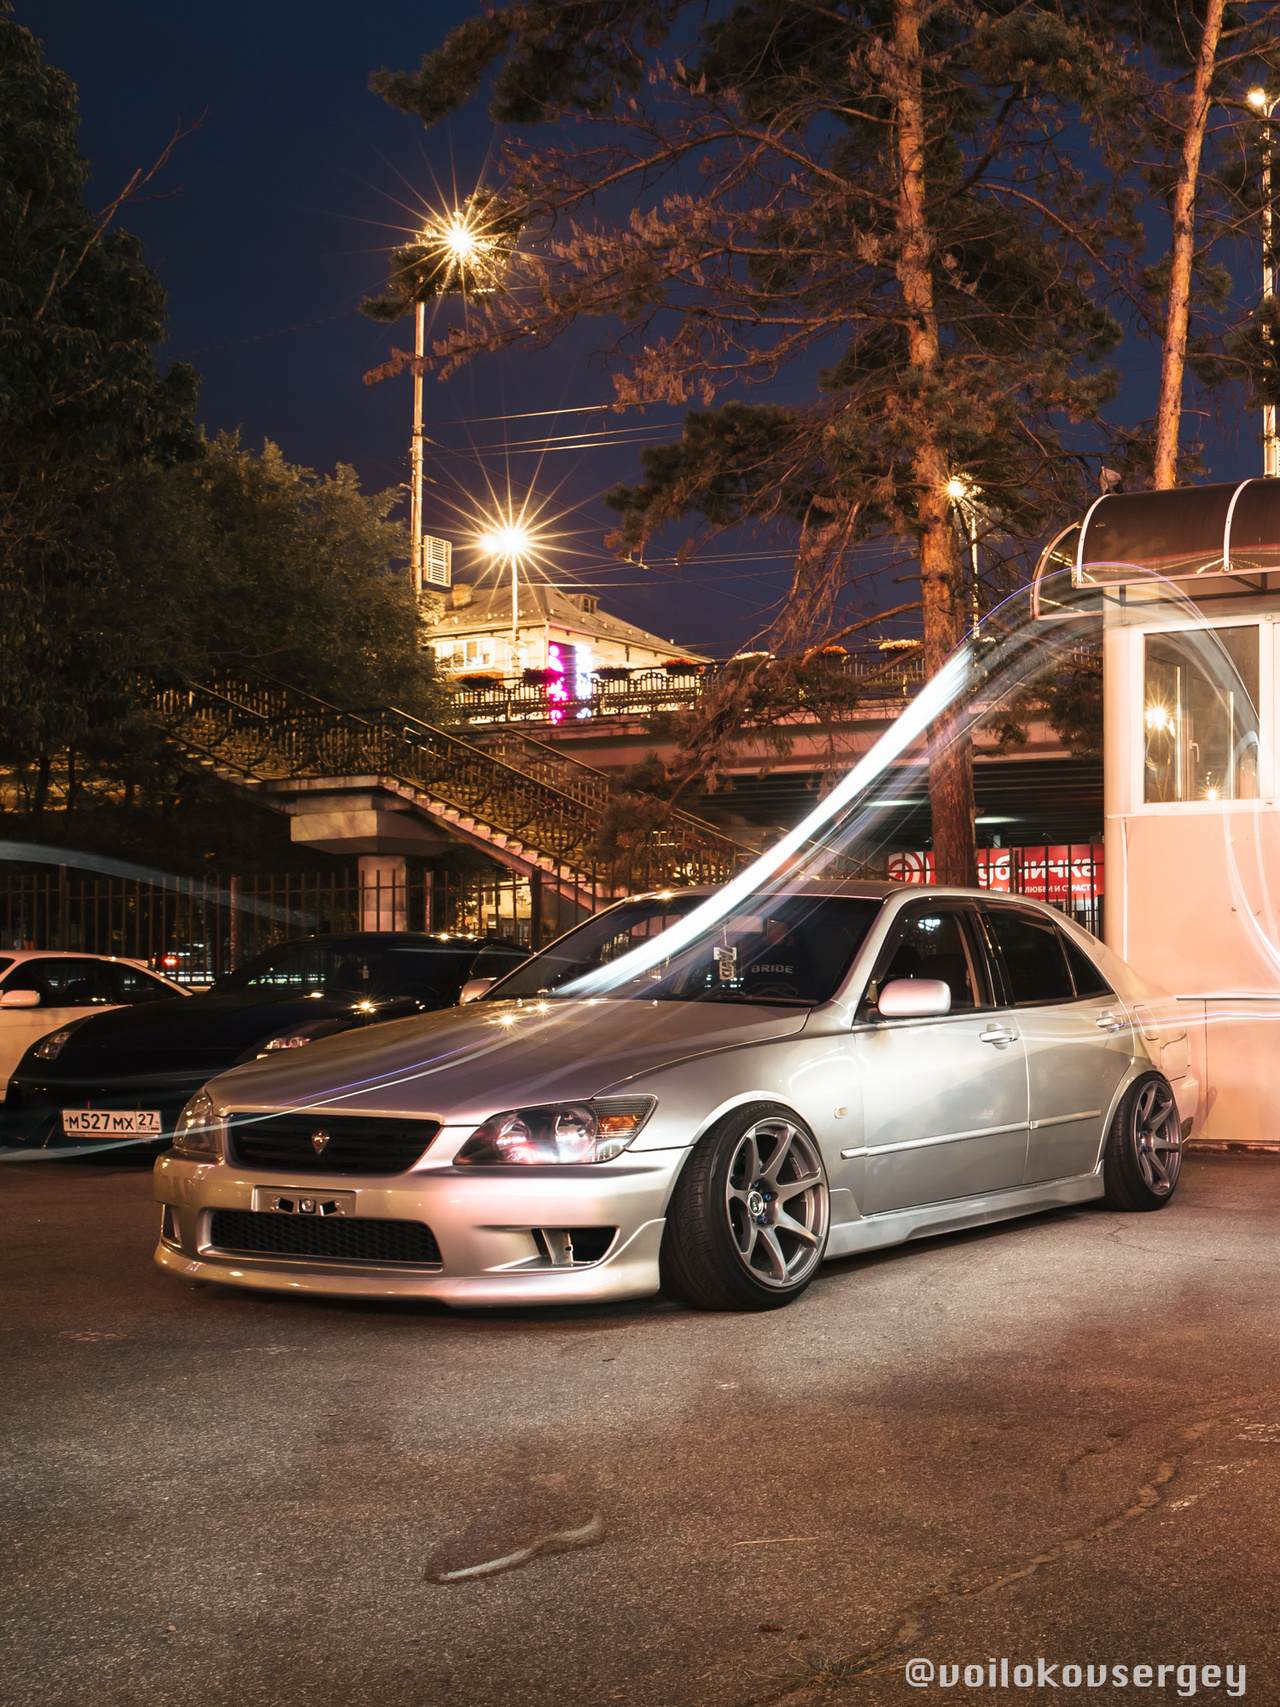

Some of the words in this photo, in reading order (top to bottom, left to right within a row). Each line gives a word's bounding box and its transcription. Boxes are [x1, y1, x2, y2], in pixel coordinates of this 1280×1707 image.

[1061, 884, 1097, 892] СРАСТ
[751, 964, 794, 974] BRIDE
[137, 1113, 154, 1126] 27
